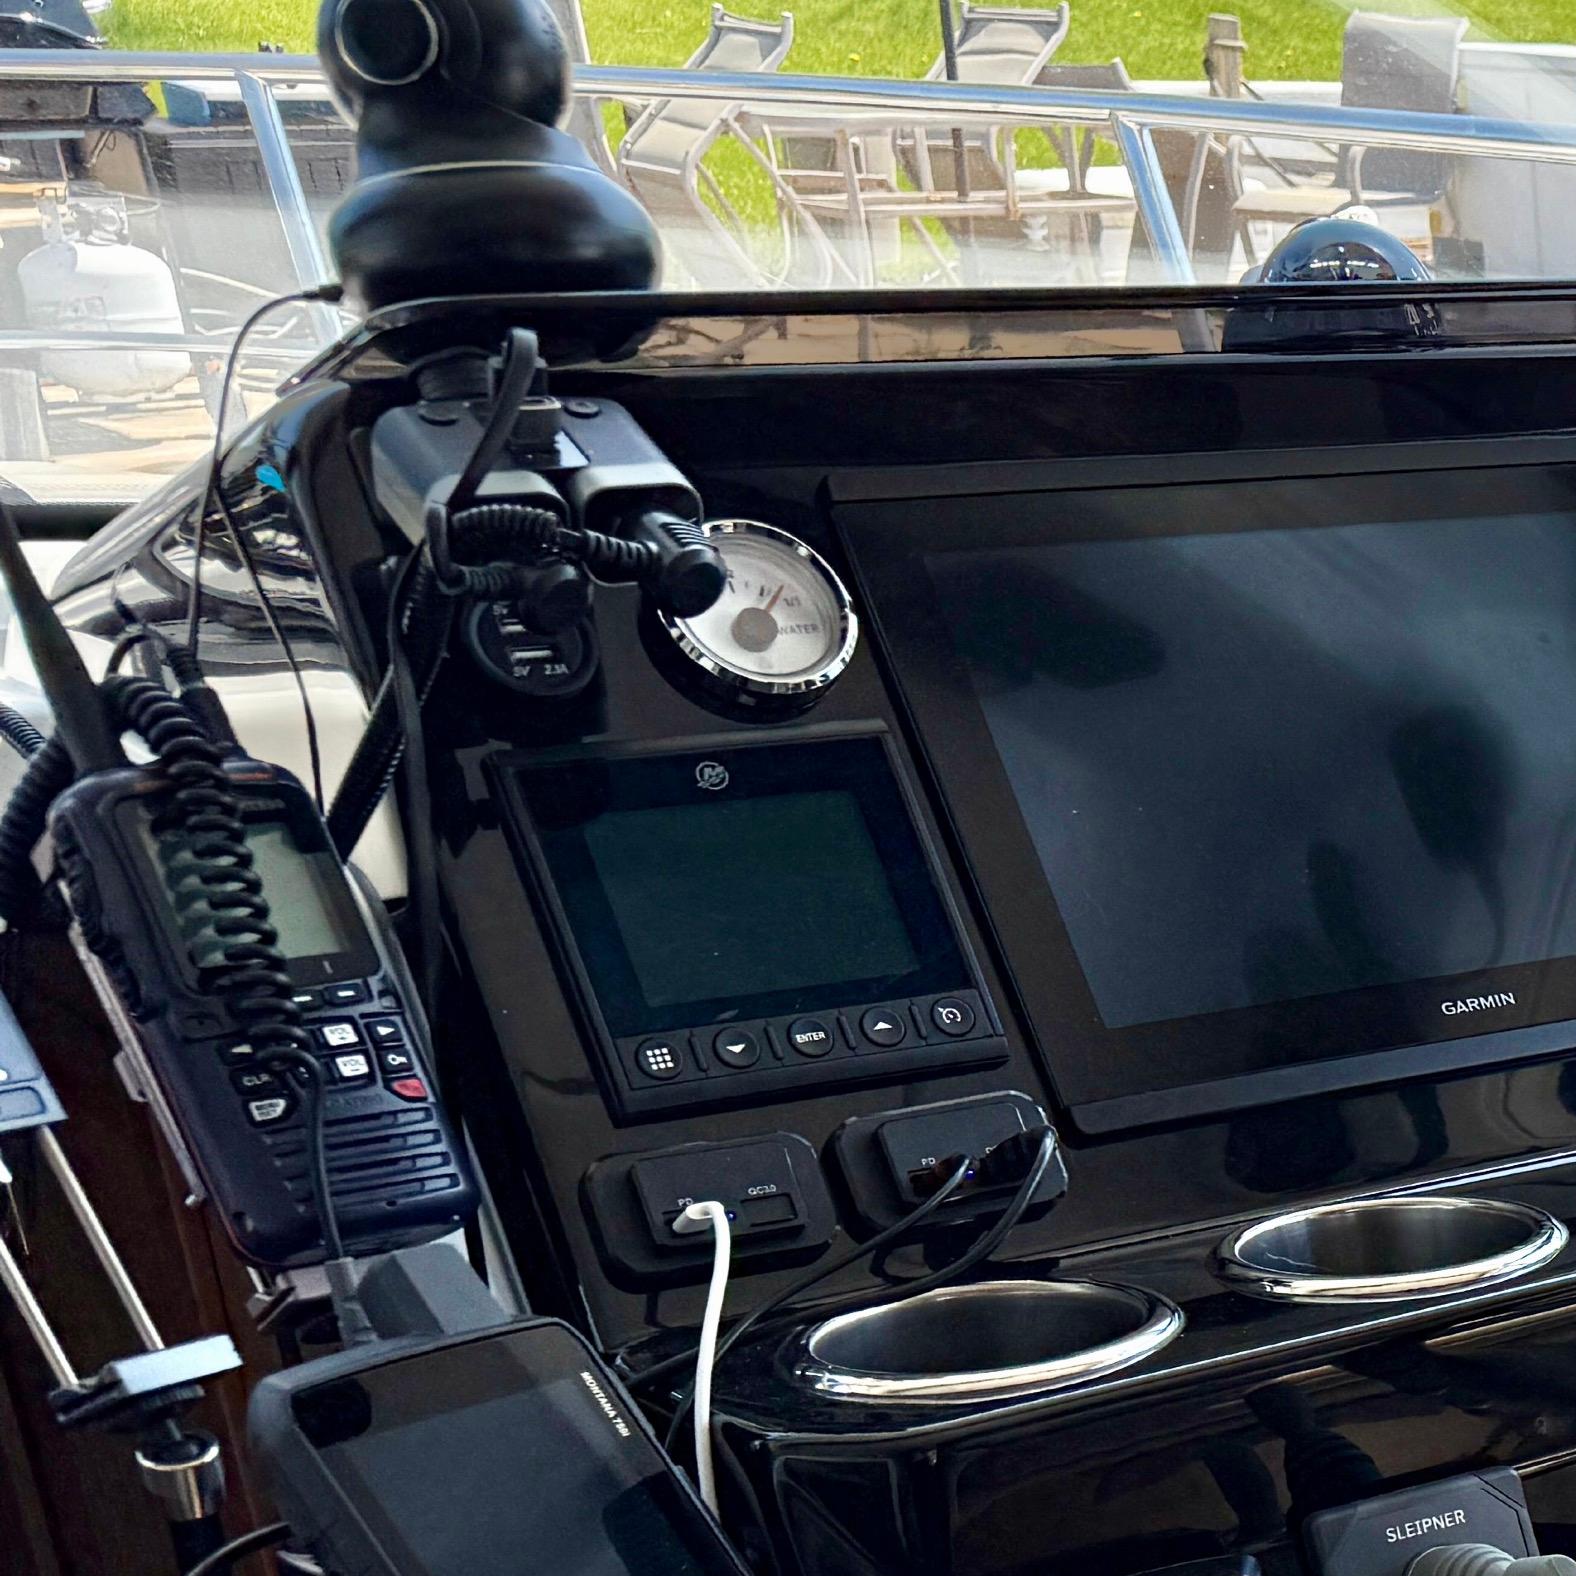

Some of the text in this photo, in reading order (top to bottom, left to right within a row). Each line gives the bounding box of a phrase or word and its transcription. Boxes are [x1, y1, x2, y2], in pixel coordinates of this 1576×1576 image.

[1441, 992, 1516, 1015] GARMIN
[796, 1031, 825, 1044] ENTER
[580, 1371, 617, 1418] MONTANA
[1386, 1509, 1466, 1544] SLEIPNER
